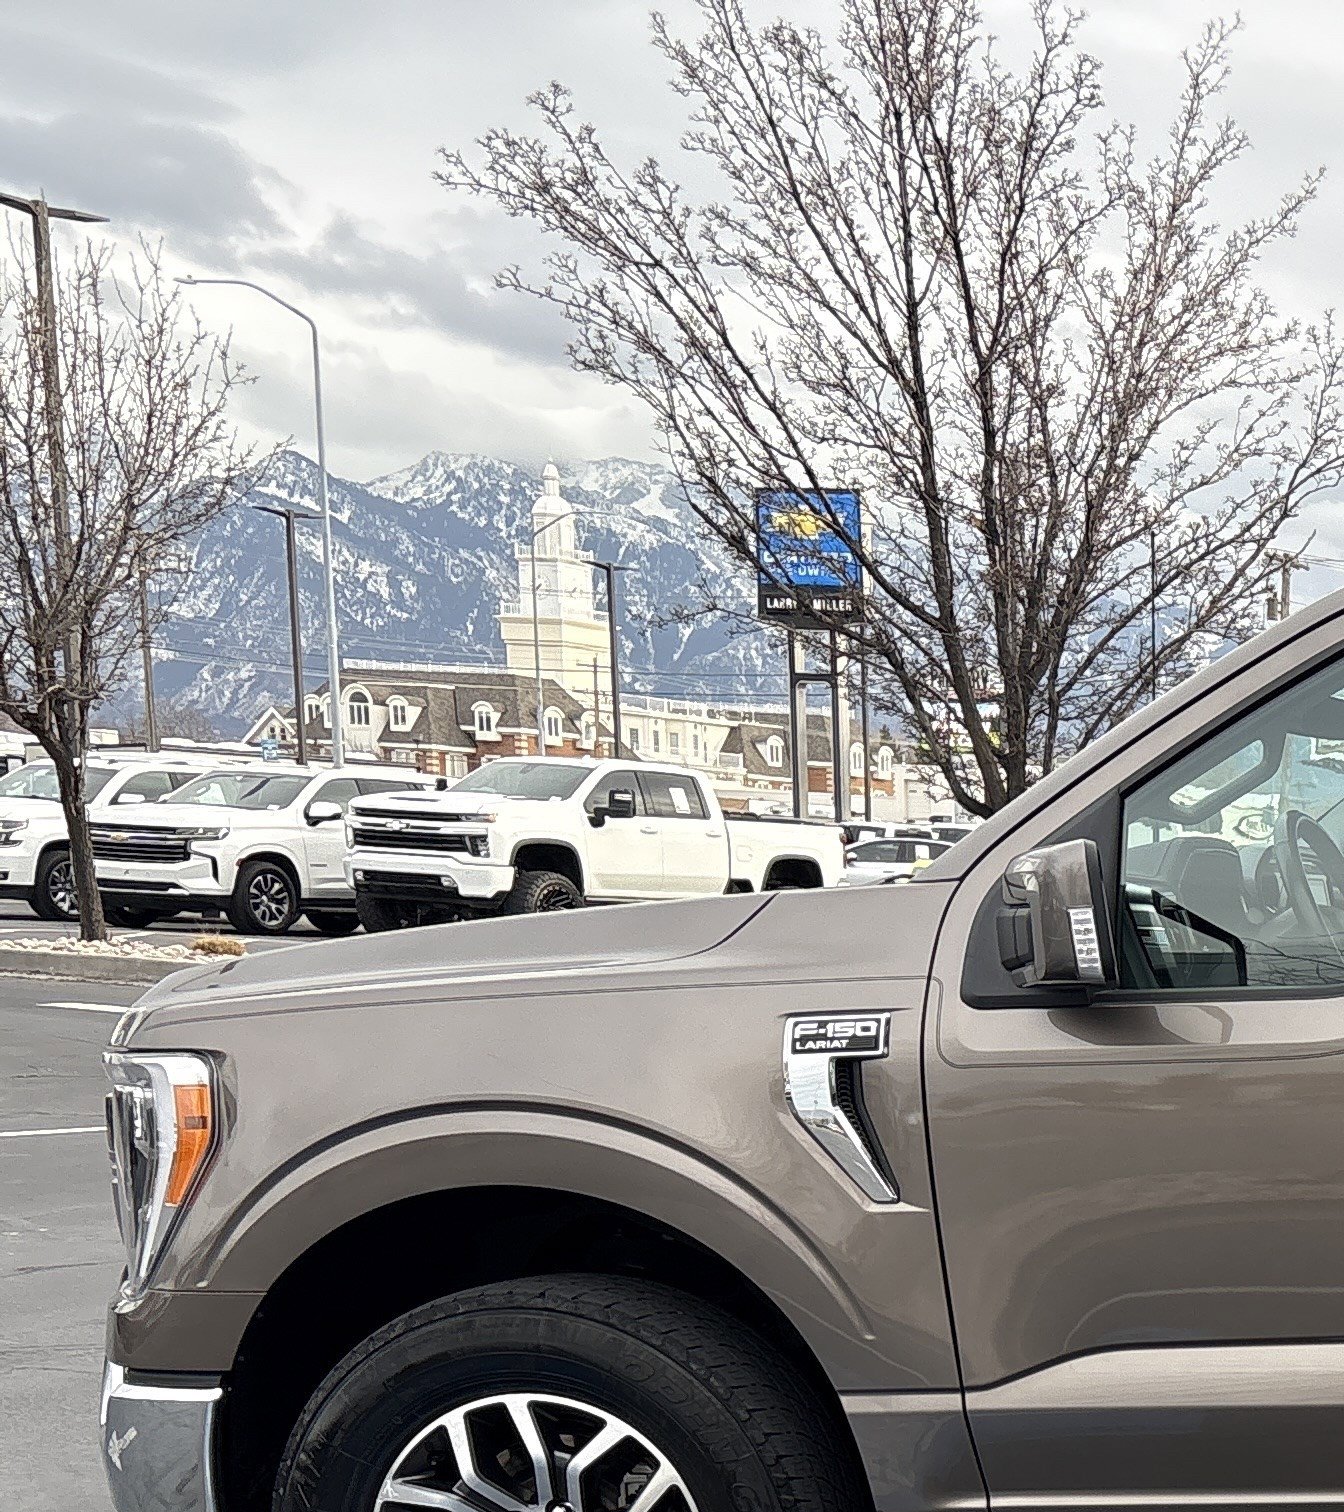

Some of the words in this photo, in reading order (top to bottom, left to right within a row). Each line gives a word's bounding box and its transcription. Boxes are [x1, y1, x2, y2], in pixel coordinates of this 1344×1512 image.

[812, 598, 852, 611] MILLER
[794, 1020, 878, 1038] F-150
[795, 1039, 849, 1050] LARIAT
